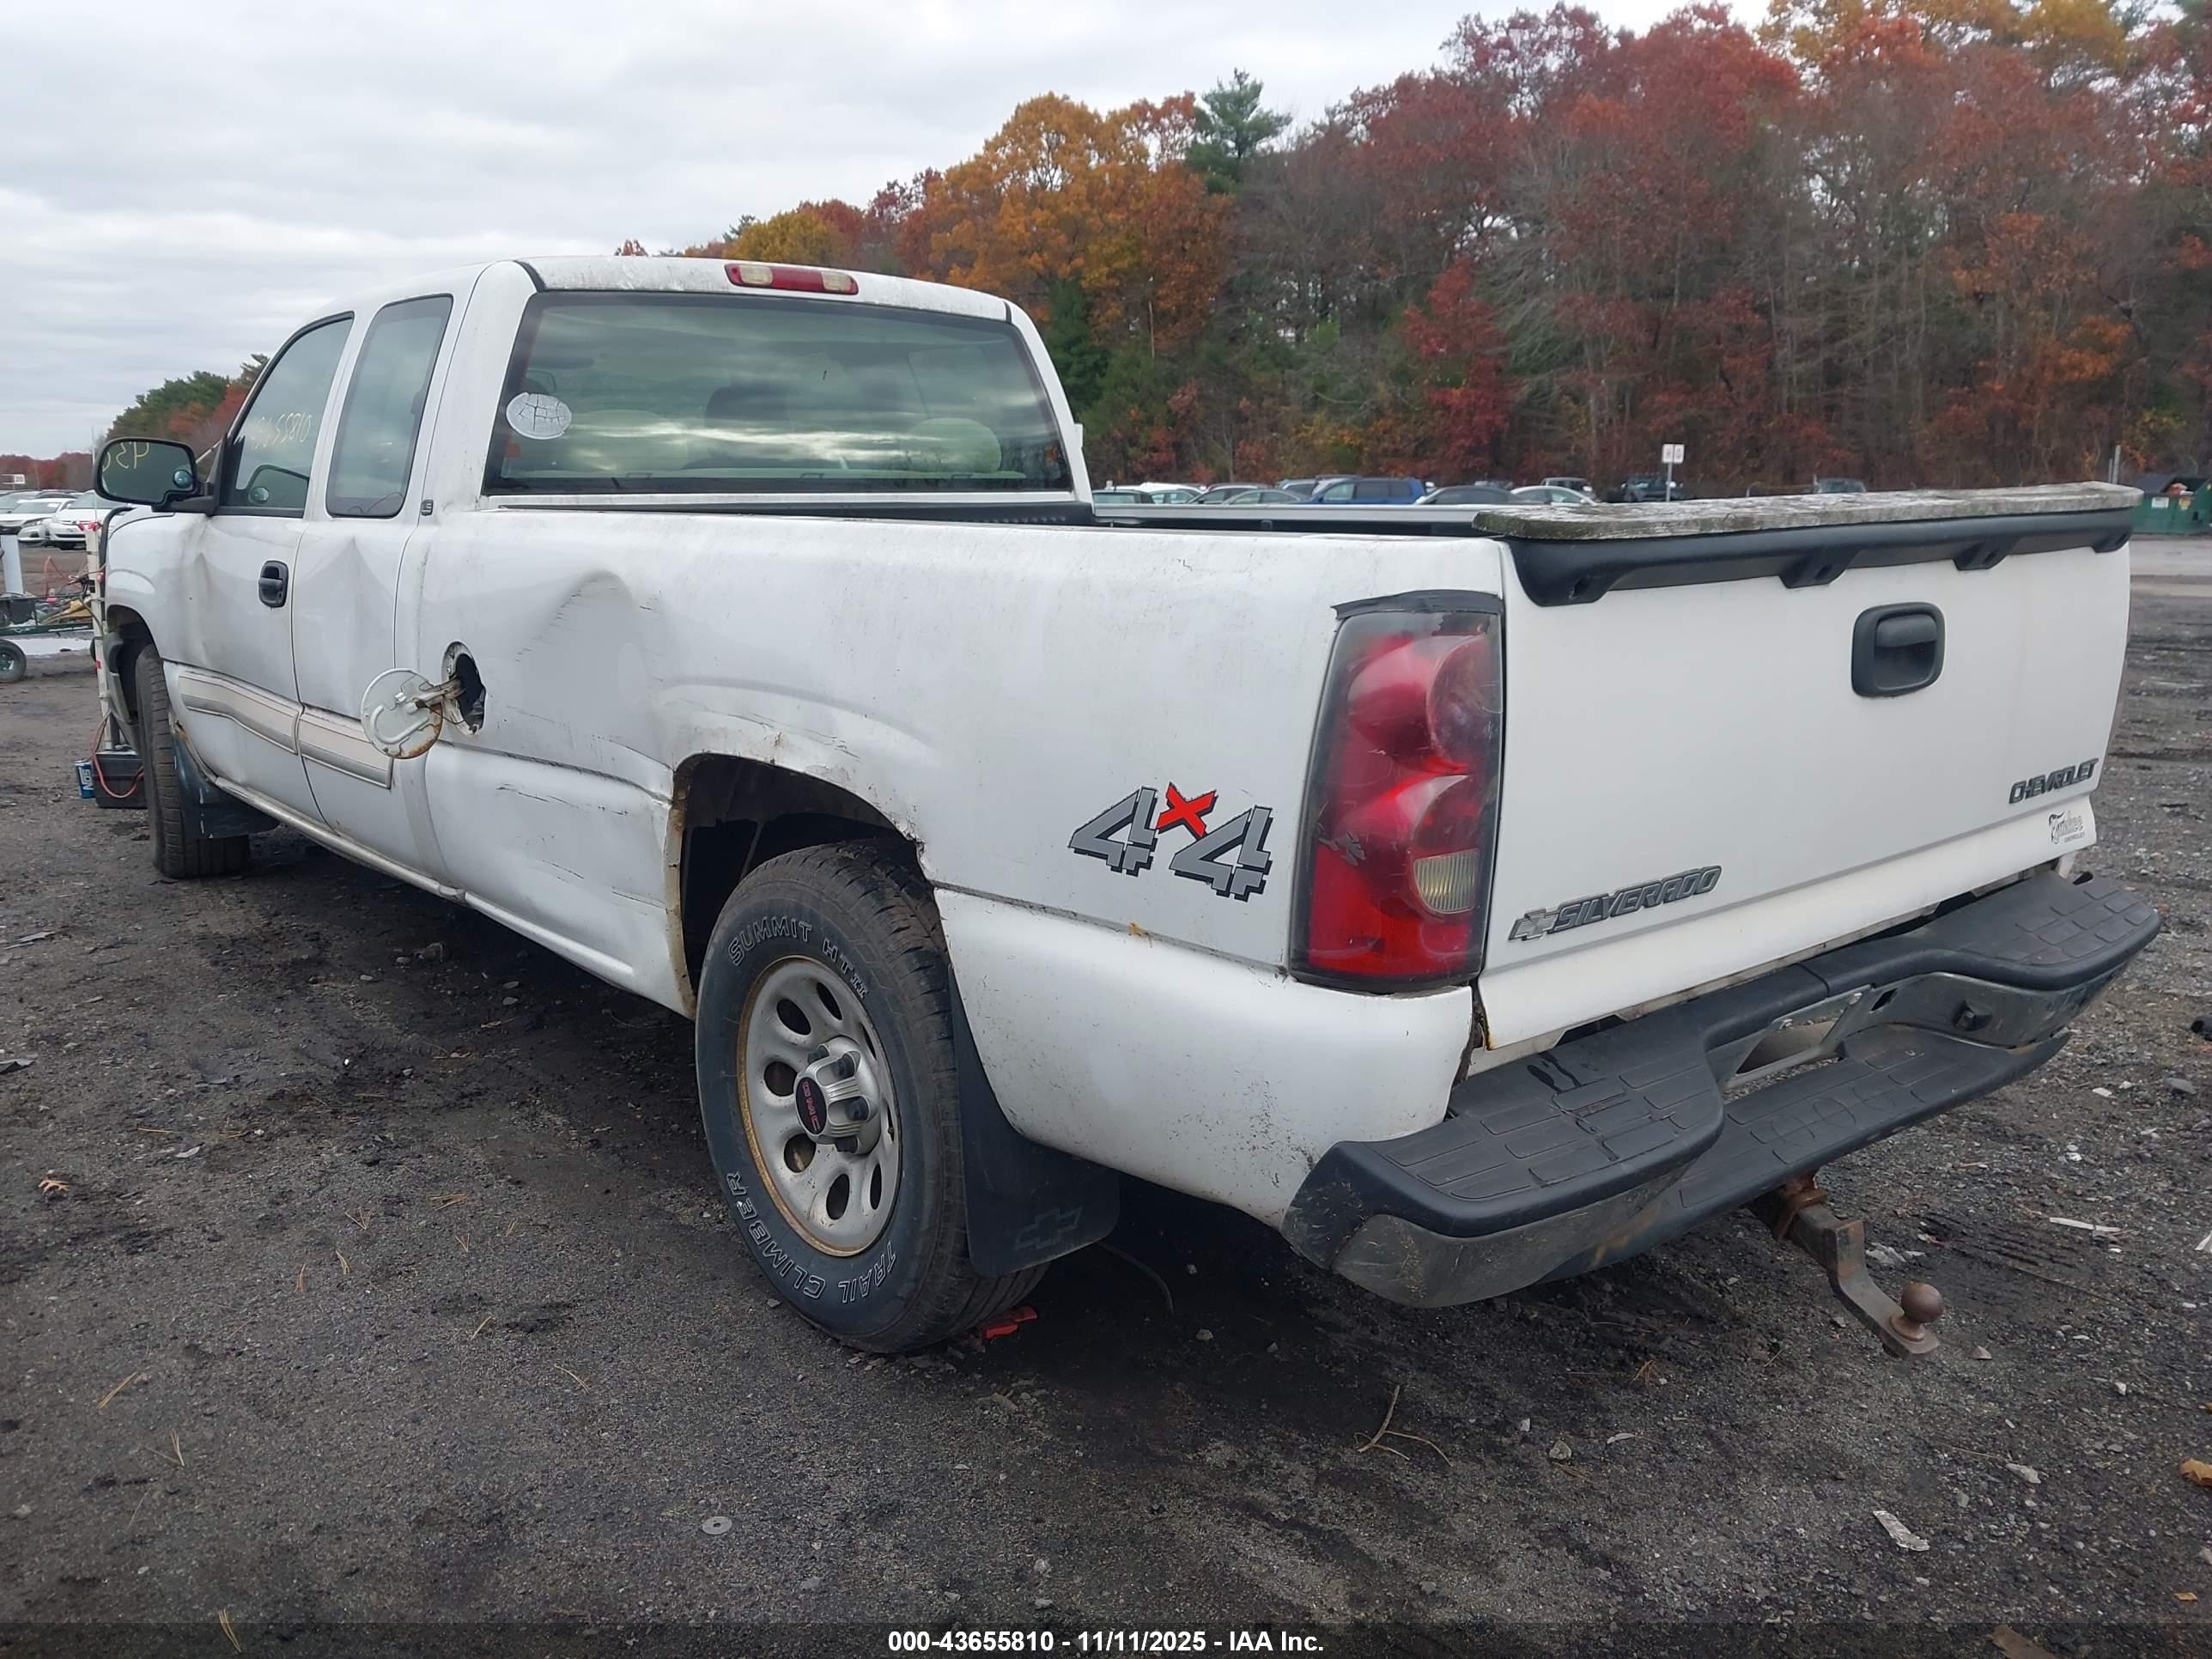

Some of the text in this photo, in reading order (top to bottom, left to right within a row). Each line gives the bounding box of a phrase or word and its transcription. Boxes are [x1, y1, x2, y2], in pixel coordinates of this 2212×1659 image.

[2009, 758, 2099, 804] CHEVROLET
[1550, 866, 1722, 933] SILVERADO
[728, 915, 812, 966] SUMMIT
[802, 1081, 821, 1132] GMC
[726, 1171, 896, 1304] TRAIL CLIMBER
